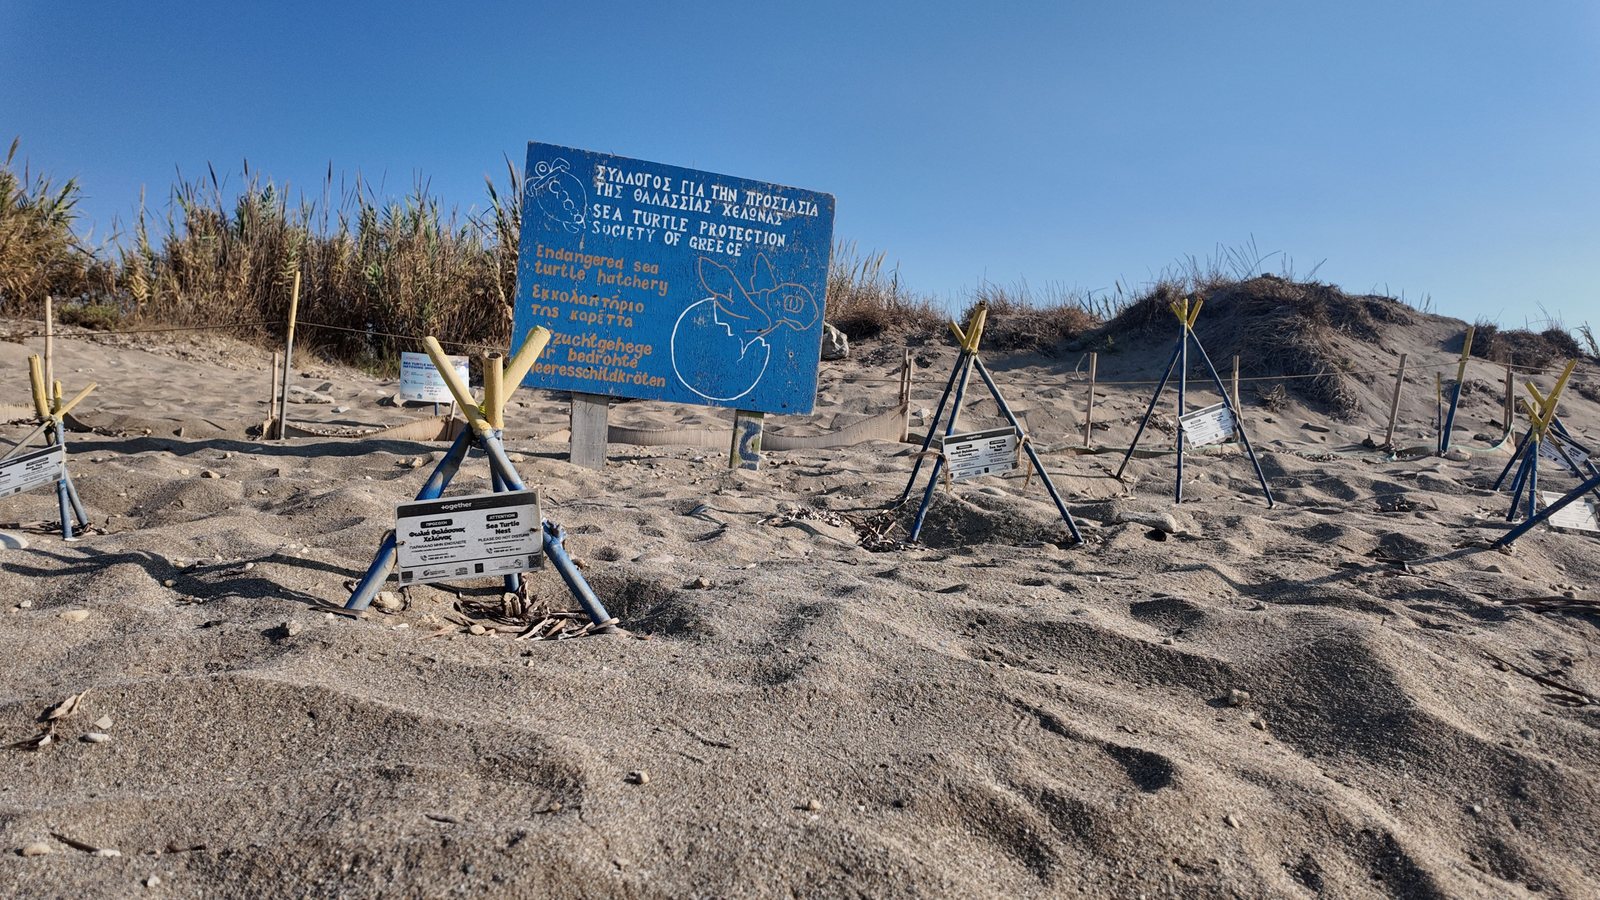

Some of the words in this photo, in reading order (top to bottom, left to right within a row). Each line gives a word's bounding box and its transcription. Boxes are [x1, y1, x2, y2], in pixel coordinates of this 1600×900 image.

[596, 164, 672, 192] ΣΥΛΛΟΓΟΣ
[680, 179, 705, 198] ΓΙΑ
[711, 184, 738, 203] ΤΗΝ
[745, 190, 819, 217] ΠΡΟΣΤΑΣΙΑ
[596, 181, 624, 199] ΤΗΣ
[633, 188, 713, 214] ΘΑΛΑΣΣΙΑΣ
[721, 202, 783, 226] ΧΕΛΩΝΑΣ
[591, 220, 656, 243] SOCIETY
[663, 230, 682, 247] OF
[688, 236, 743, 257] GREECE
[592, 203, 623, 222] SEA
[632, 209, 689, 232] TURTLE
[699, 220, 787, 247] PROTECTION
[536, 244, 625, 270] Endangered
[633, 260, 660, 275] sea
[534, 260, 586, 280] turtle
[597, 268, 669, 297] hatchery
[567, 347, 638, 369] bedrohte
